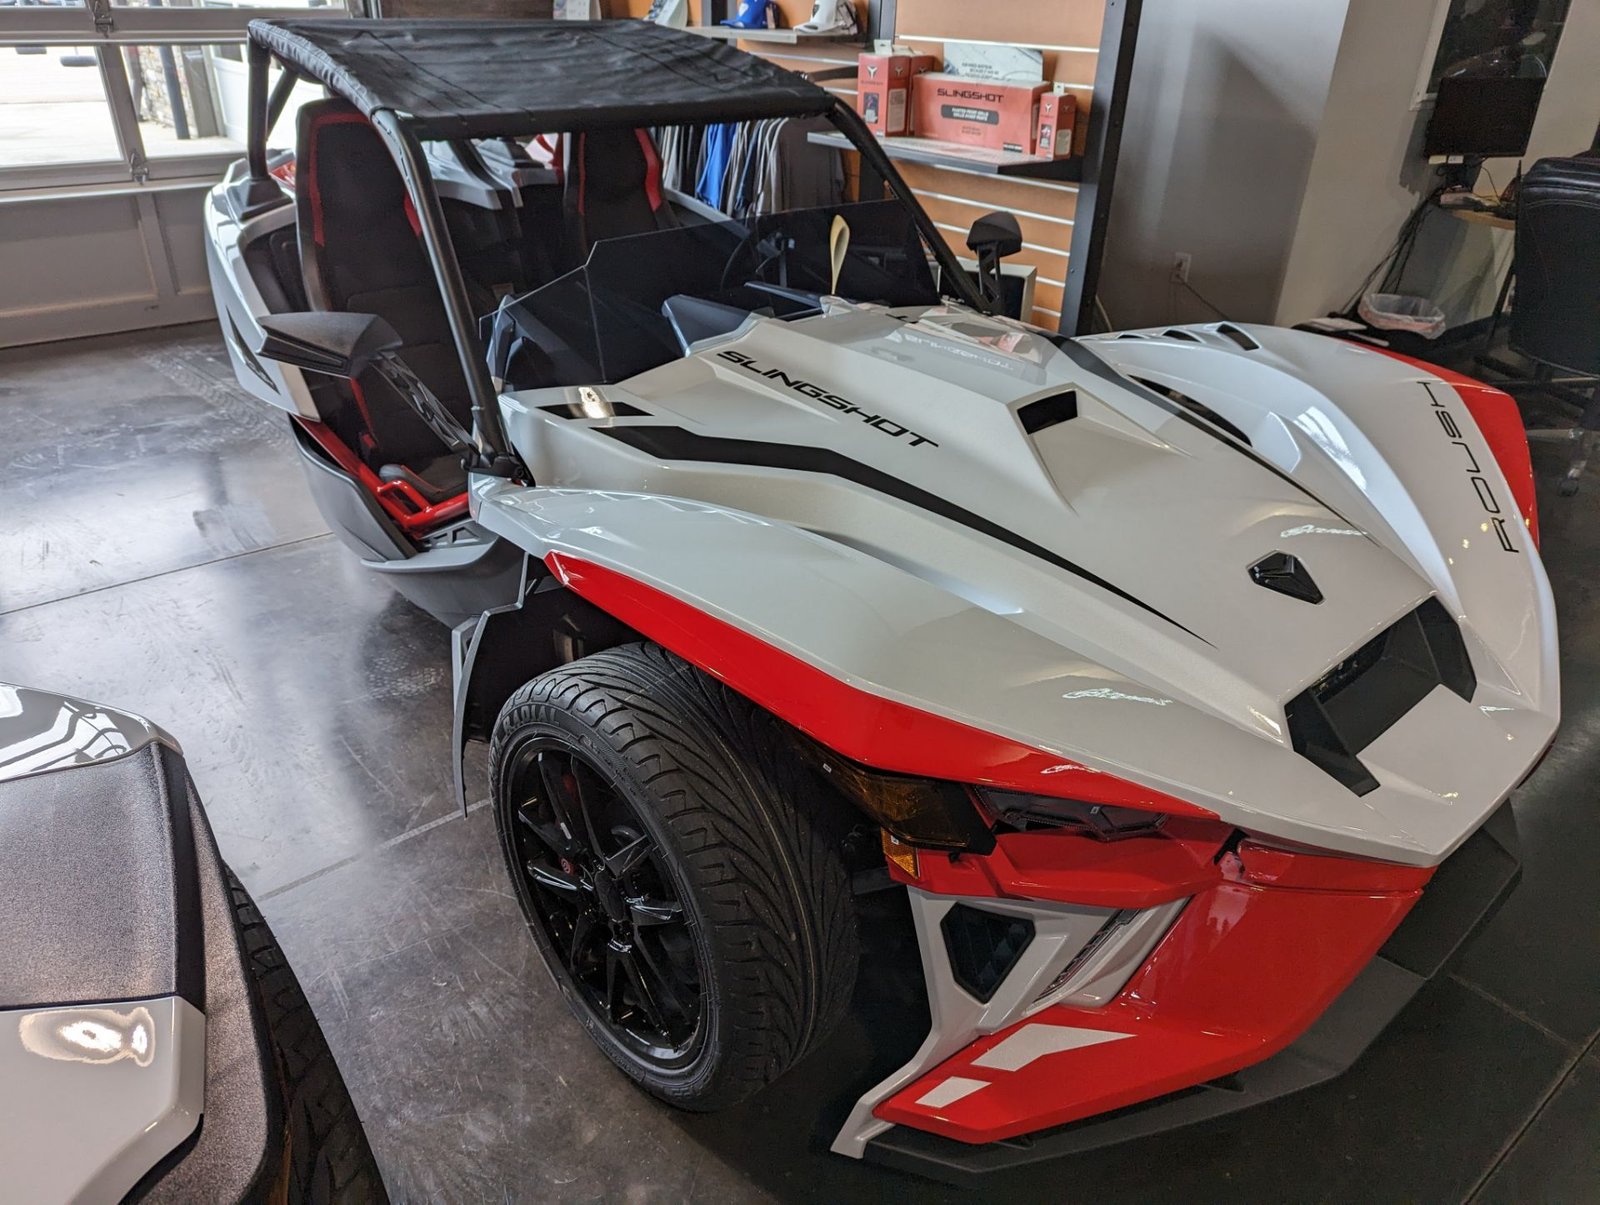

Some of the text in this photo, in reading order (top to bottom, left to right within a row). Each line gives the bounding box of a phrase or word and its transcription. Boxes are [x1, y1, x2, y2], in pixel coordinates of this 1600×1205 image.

[937, 88, 1004, 103] SLINGSHOT
[717, 350, 939, 448] SLINGSHOT
[1416, 381, 1519, 553] ROUSH
[503, 704, 560, 735] RADIAL
